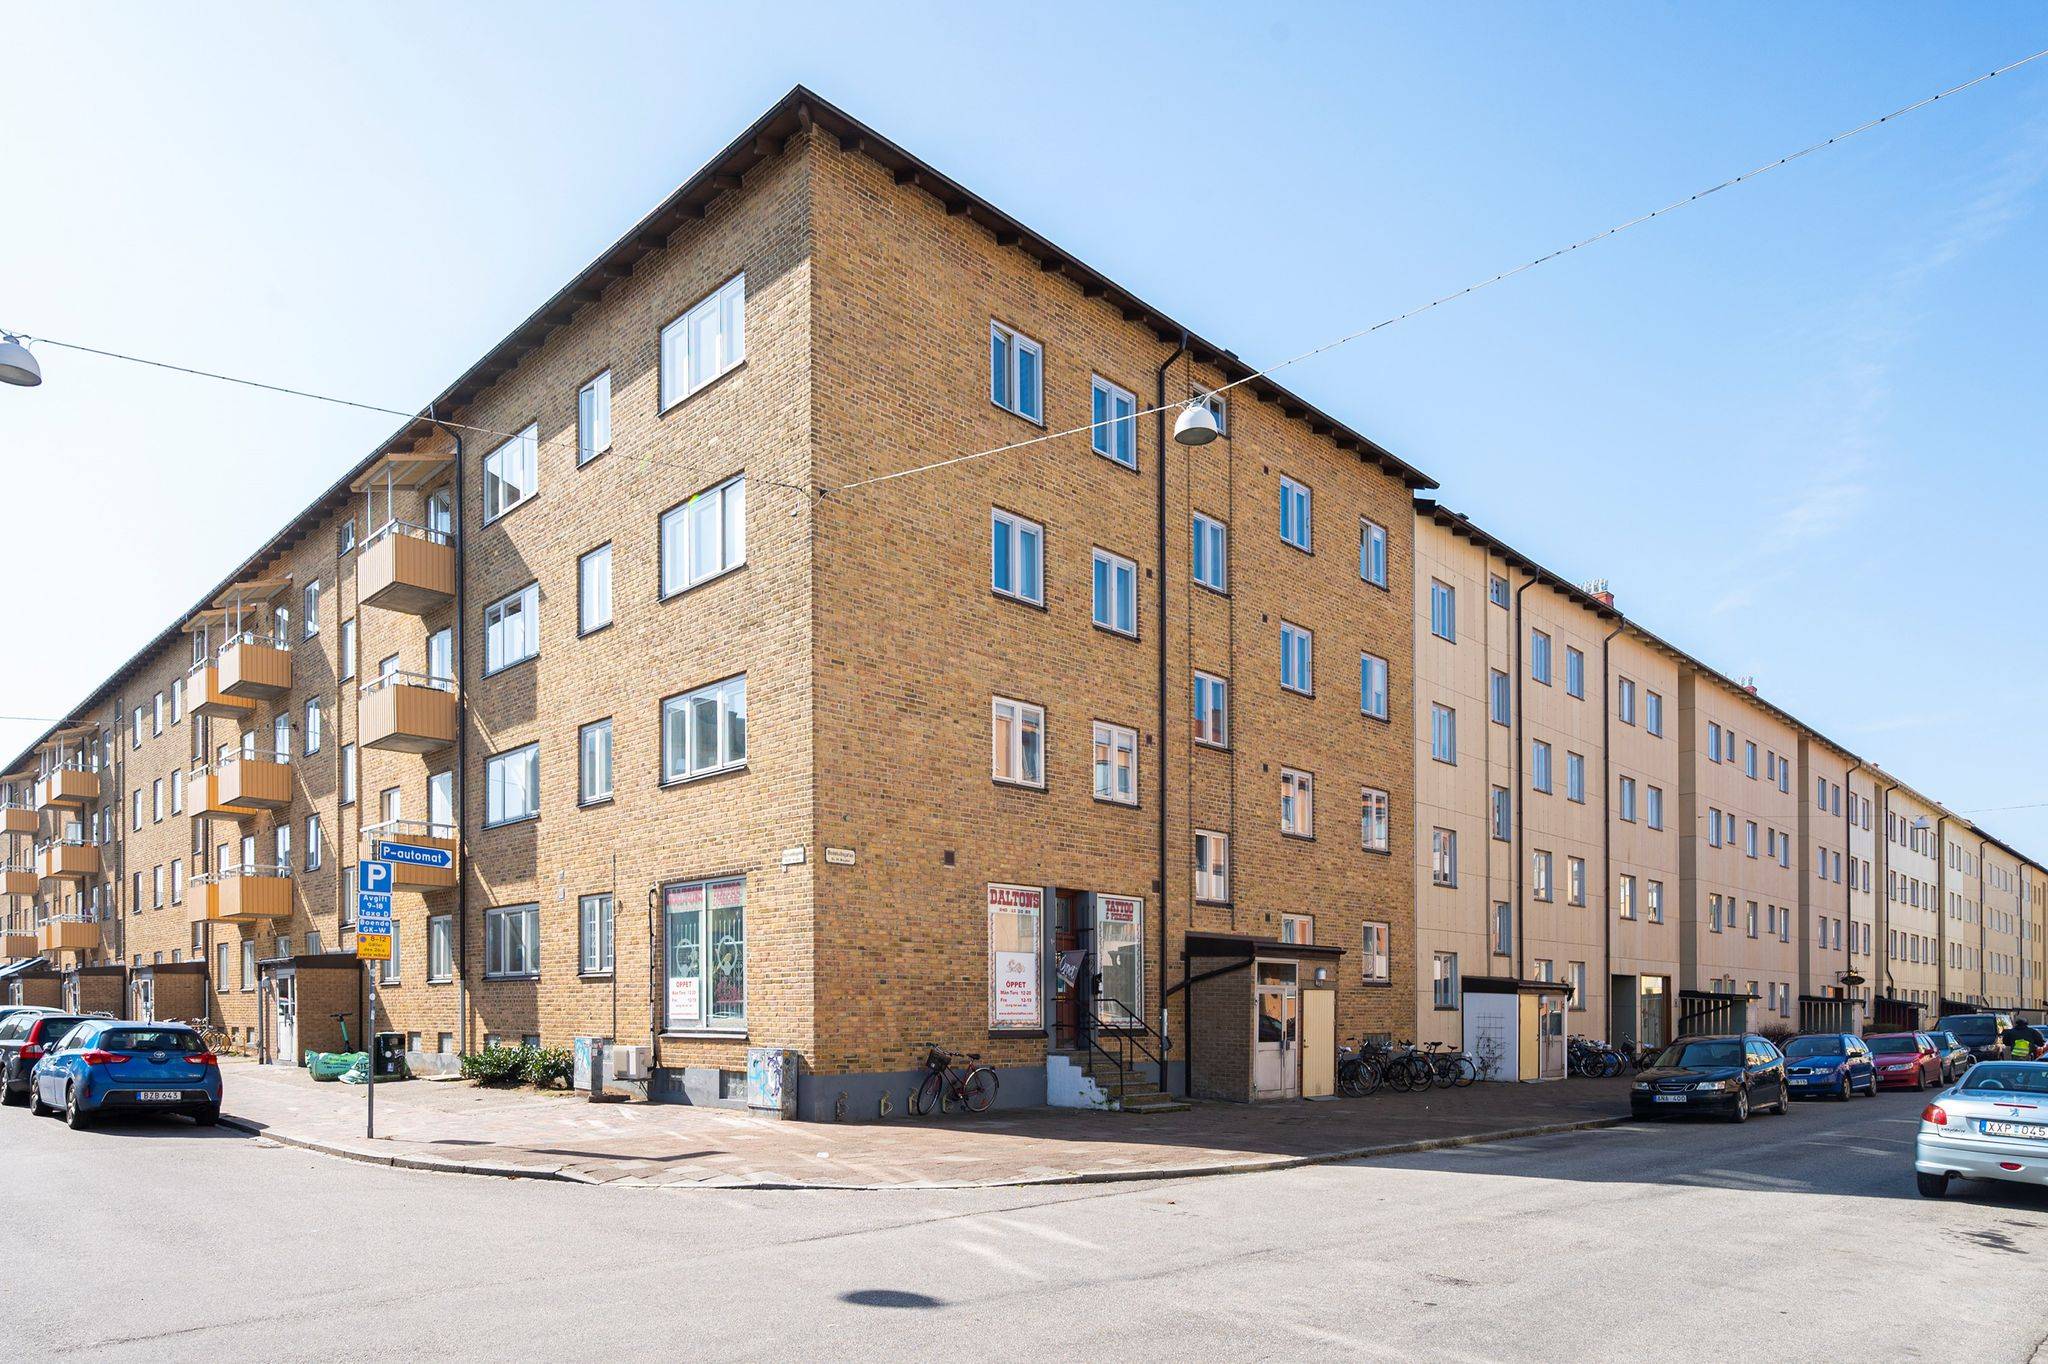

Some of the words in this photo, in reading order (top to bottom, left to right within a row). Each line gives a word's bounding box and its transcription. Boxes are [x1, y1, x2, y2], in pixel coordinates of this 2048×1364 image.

[383, 846, 442, 863] P-automat
[368, 863, 387, 890] P
[363, 894, 388, 903] Avgift
[989, 888, 1039, 908] DALTONS
[367, 902, 384, 910] 9-18
[1105, 900, 1134, 914] TATTOO
[361, 909, 381, 917] Taxa
[383, 910, 389, 918] D
[360, 919, 390, 927] Boende
[1005, 980, 1026, 988] ÖPPET
[1988, 1122, 2012, 1133] XXP
[2021, 1125, 2047, 1137] 045
